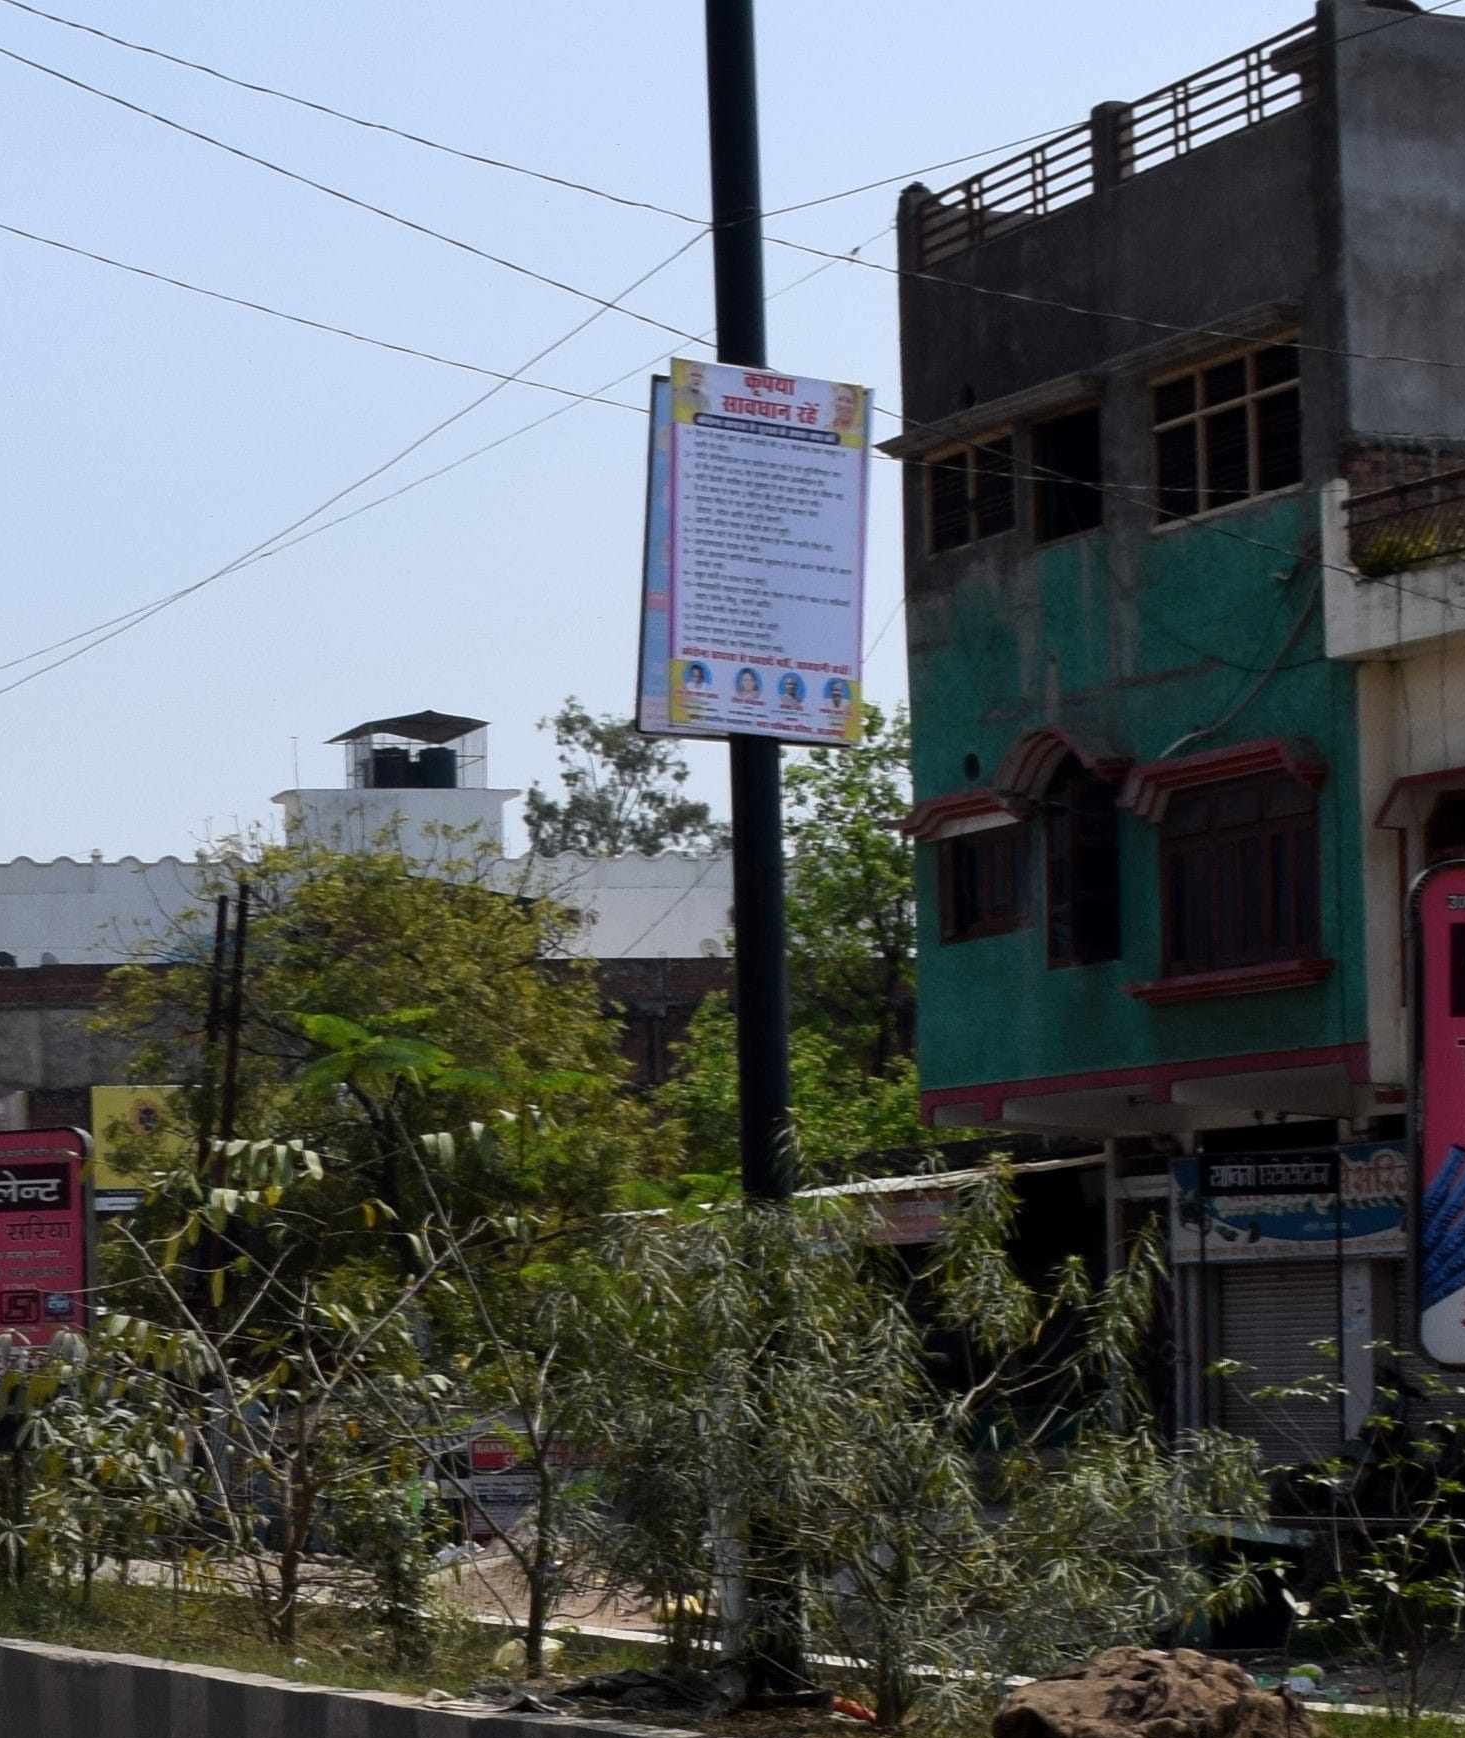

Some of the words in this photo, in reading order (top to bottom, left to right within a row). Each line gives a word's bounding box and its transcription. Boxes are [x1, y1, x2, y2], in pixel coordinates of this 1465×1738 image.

[743, 371, 796, 399] कृपया
[721, 393, 791, 423] सावधान
[797, 400, 820, 425] रहें
[6, 1215, 72, 1242] सरिया
